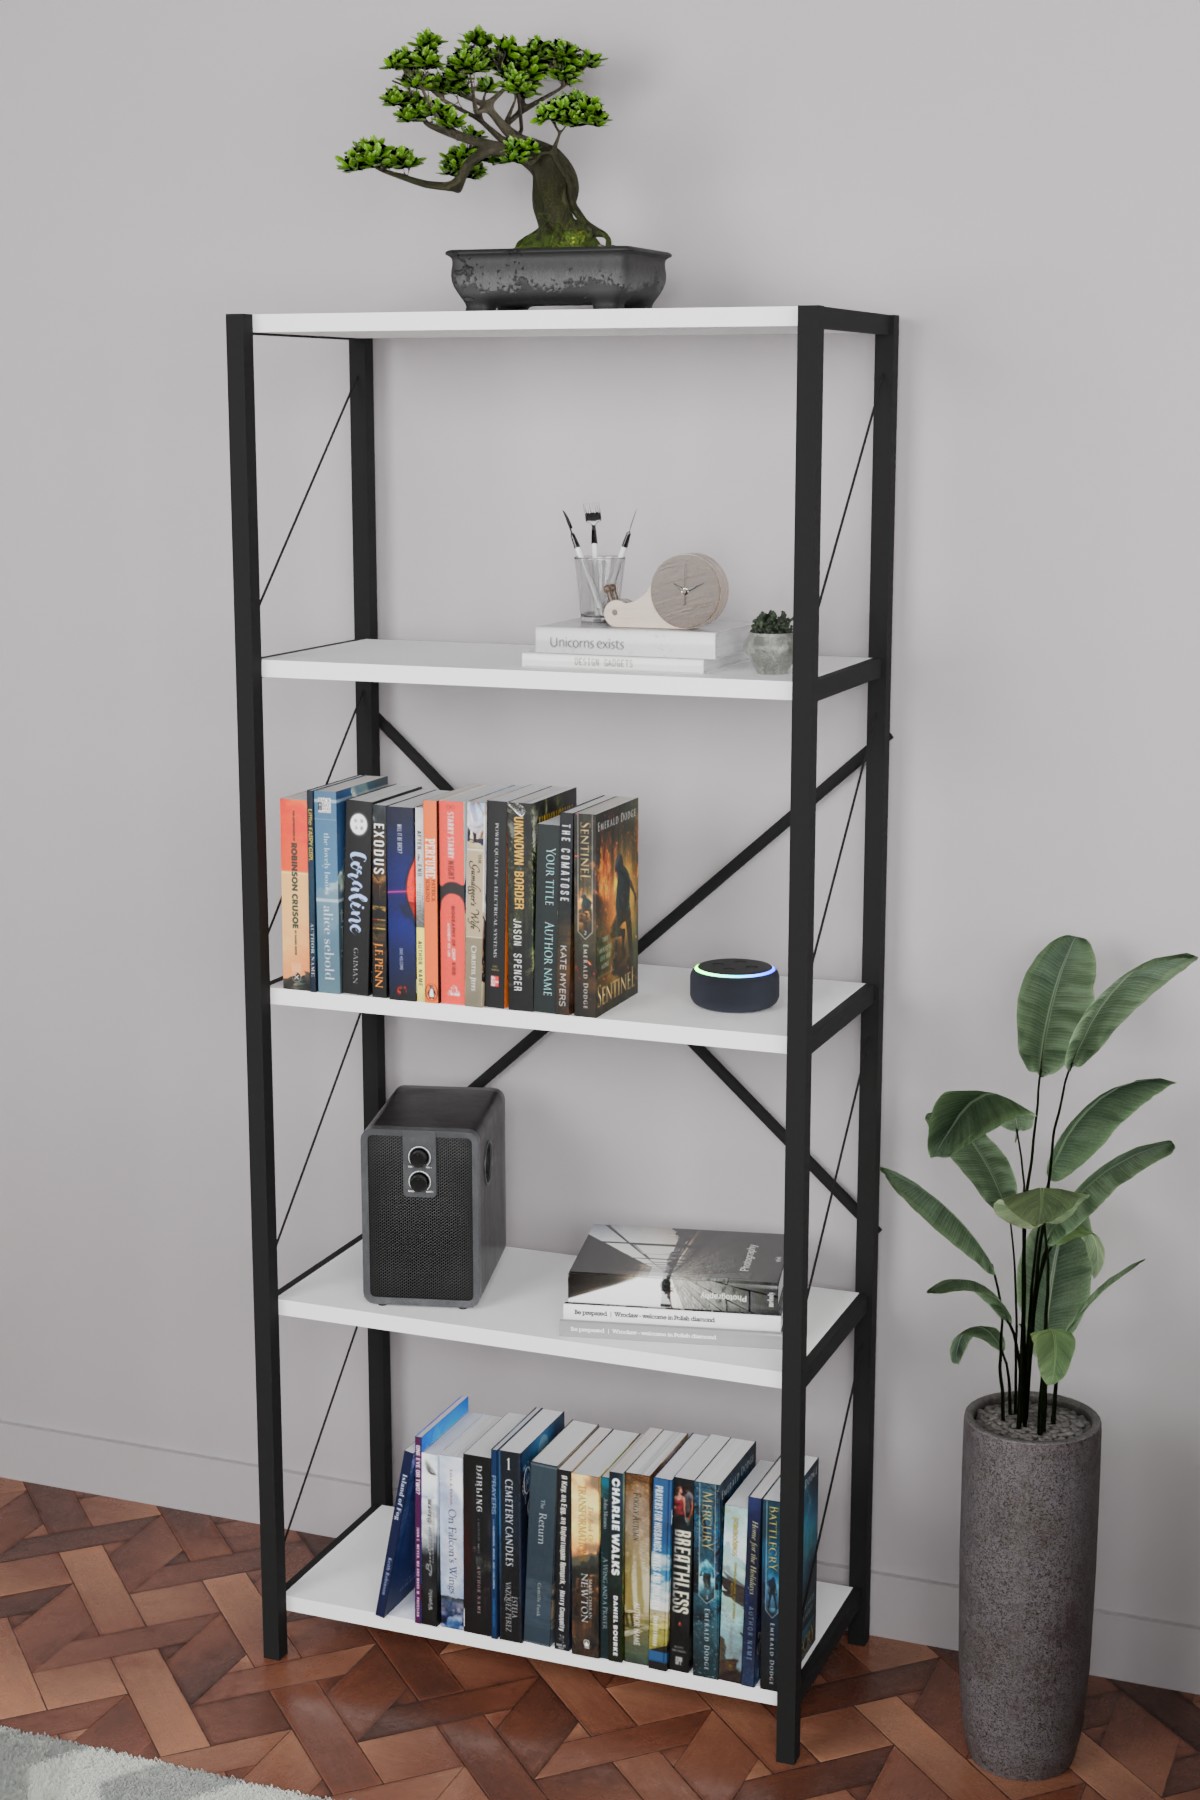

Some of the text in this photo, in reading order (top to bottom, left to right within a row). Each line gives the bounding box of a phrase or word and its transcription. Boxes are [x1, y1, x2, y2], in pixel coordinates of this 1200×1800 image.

[550, 637, 624, 650] Unicorns exists
[574, 658, 634, 668] DESIGN GADGETS
[598, 808, 637, 832] EMERALD DODGE
[373, 822, 385, 875] EXODUS
[425, 838, 436, 879] PERFUME
[514, 816, 524, 910] UNKNOWN BORDER
[560, 824, 571, 902] THE COMATOSE
[580, 822, 592, 880] SENTINEL
[348, 851, 368, 934] Coraline
[545, 848, 556, 906] YOUR TITLE
[323, 905, 336, 980] alice sebold
[468, 909, 480, 932] Wife
[513, 918, 522, 991] JASON SPENCER
[543, 922, 555, 996] AUTHOR NAME
[558, 972, 566, 1007] MYERS
[597, 966, 634, 1008] SENTINEL
[394, 1474, 408, 1521] Island of Fog
[448, 1509, 456, 1524] On
[632, 1492, 641, 1542] FOGGY AUTUMN
[654, 1485, 664, 1510] PRAYERS
[654, 1510, 664, 1521] FOR
[702, 1491, 715, 1551] MERCURY
[448, 1527, 457, 1564] Falcon's
[504, 1478, 514, 1567] CEMETERY CANDLES
[538, 1512, 547, 1545] Return
[611, 1477, 621, 1576] CHARLIE WALKS
[750, 1540, 758, 1553] for
[768, 1506, 780, 1572] BATTLECRY
[448, 1566, 457, 1594] Wings
[672, 1529, 692, 1615] BREATHLESS
[748, 1566, 757, 1595] Holidays
[580, 1572, 588, 1624] NEWTON
